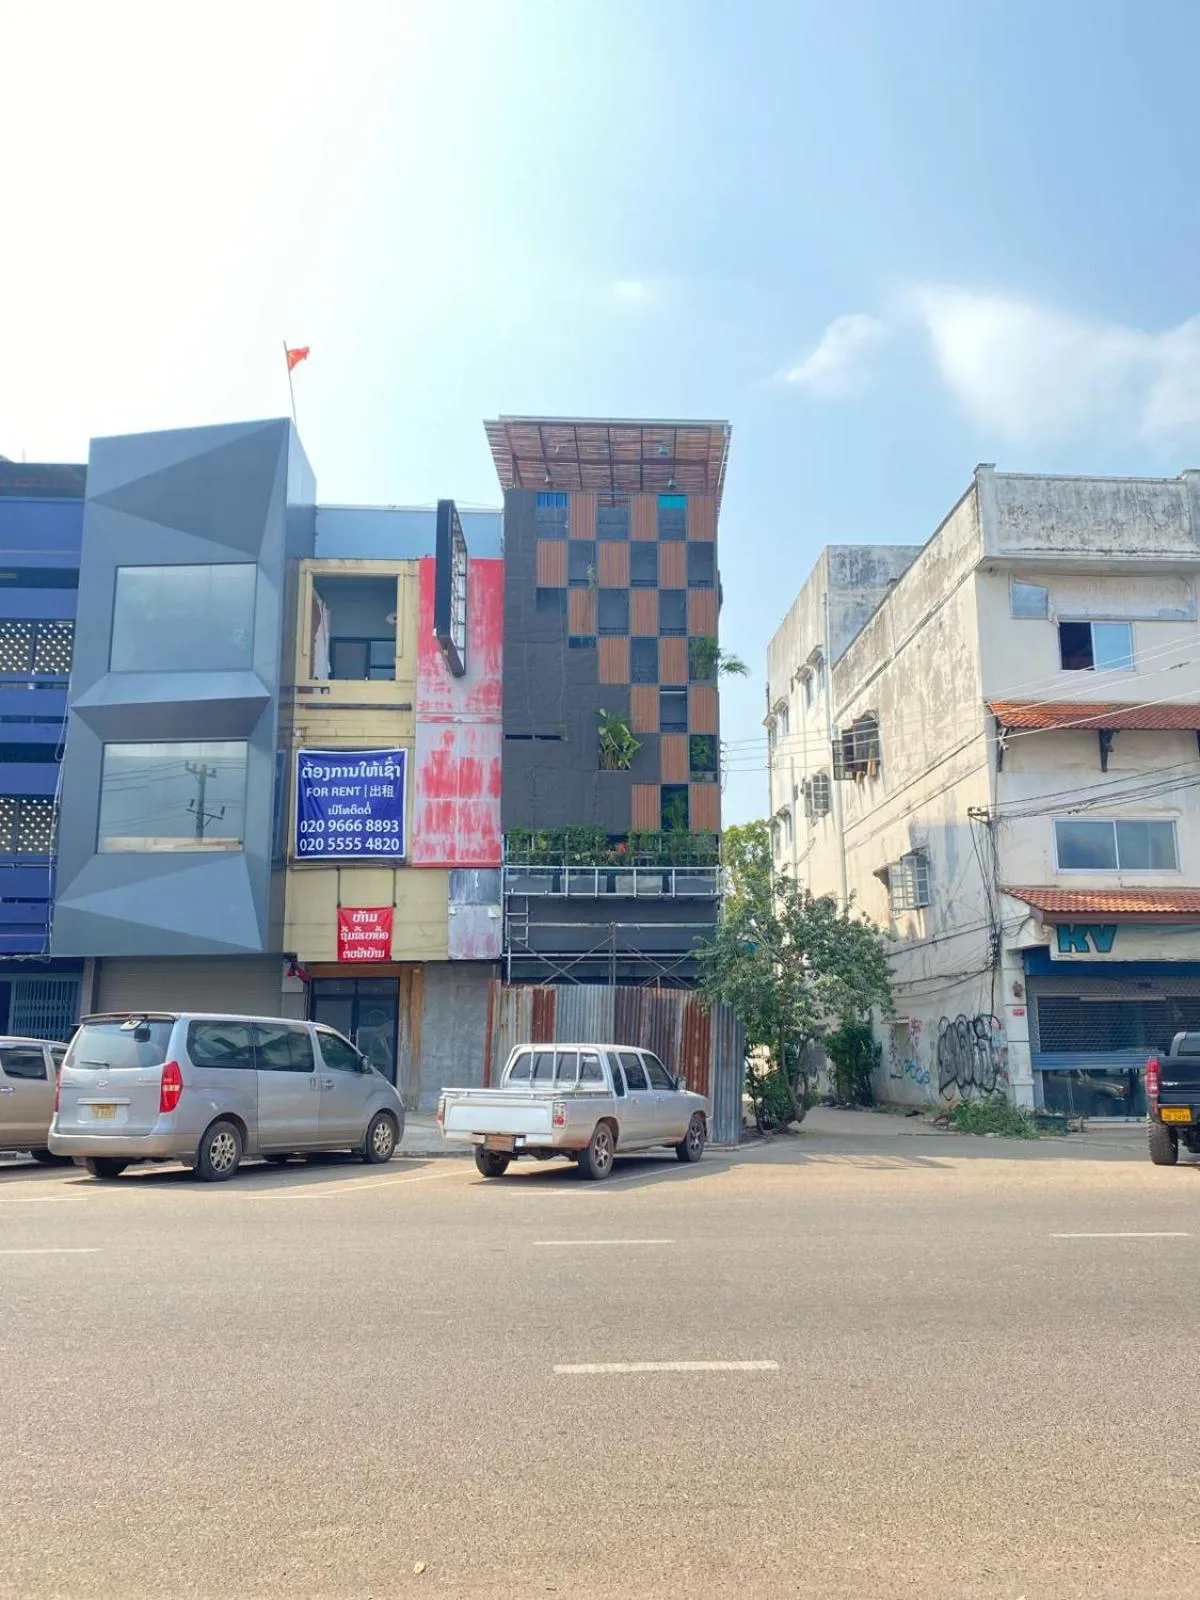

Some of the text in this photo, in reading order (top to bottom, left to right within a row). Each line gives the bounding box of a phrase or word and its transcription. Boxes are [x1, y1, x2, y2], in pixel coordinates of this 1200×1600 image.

[302, 756, 401, 781] ຕ້ອງການໃຫ້ເຊົ່າ
[306, 784, 395, 798] FOR RENT 出租
[300, 819, 400, 833] 020 9666 8893
[299, 837, 400, 851] 020 5555 4820
[1056, 923, 1118, 953] KV
